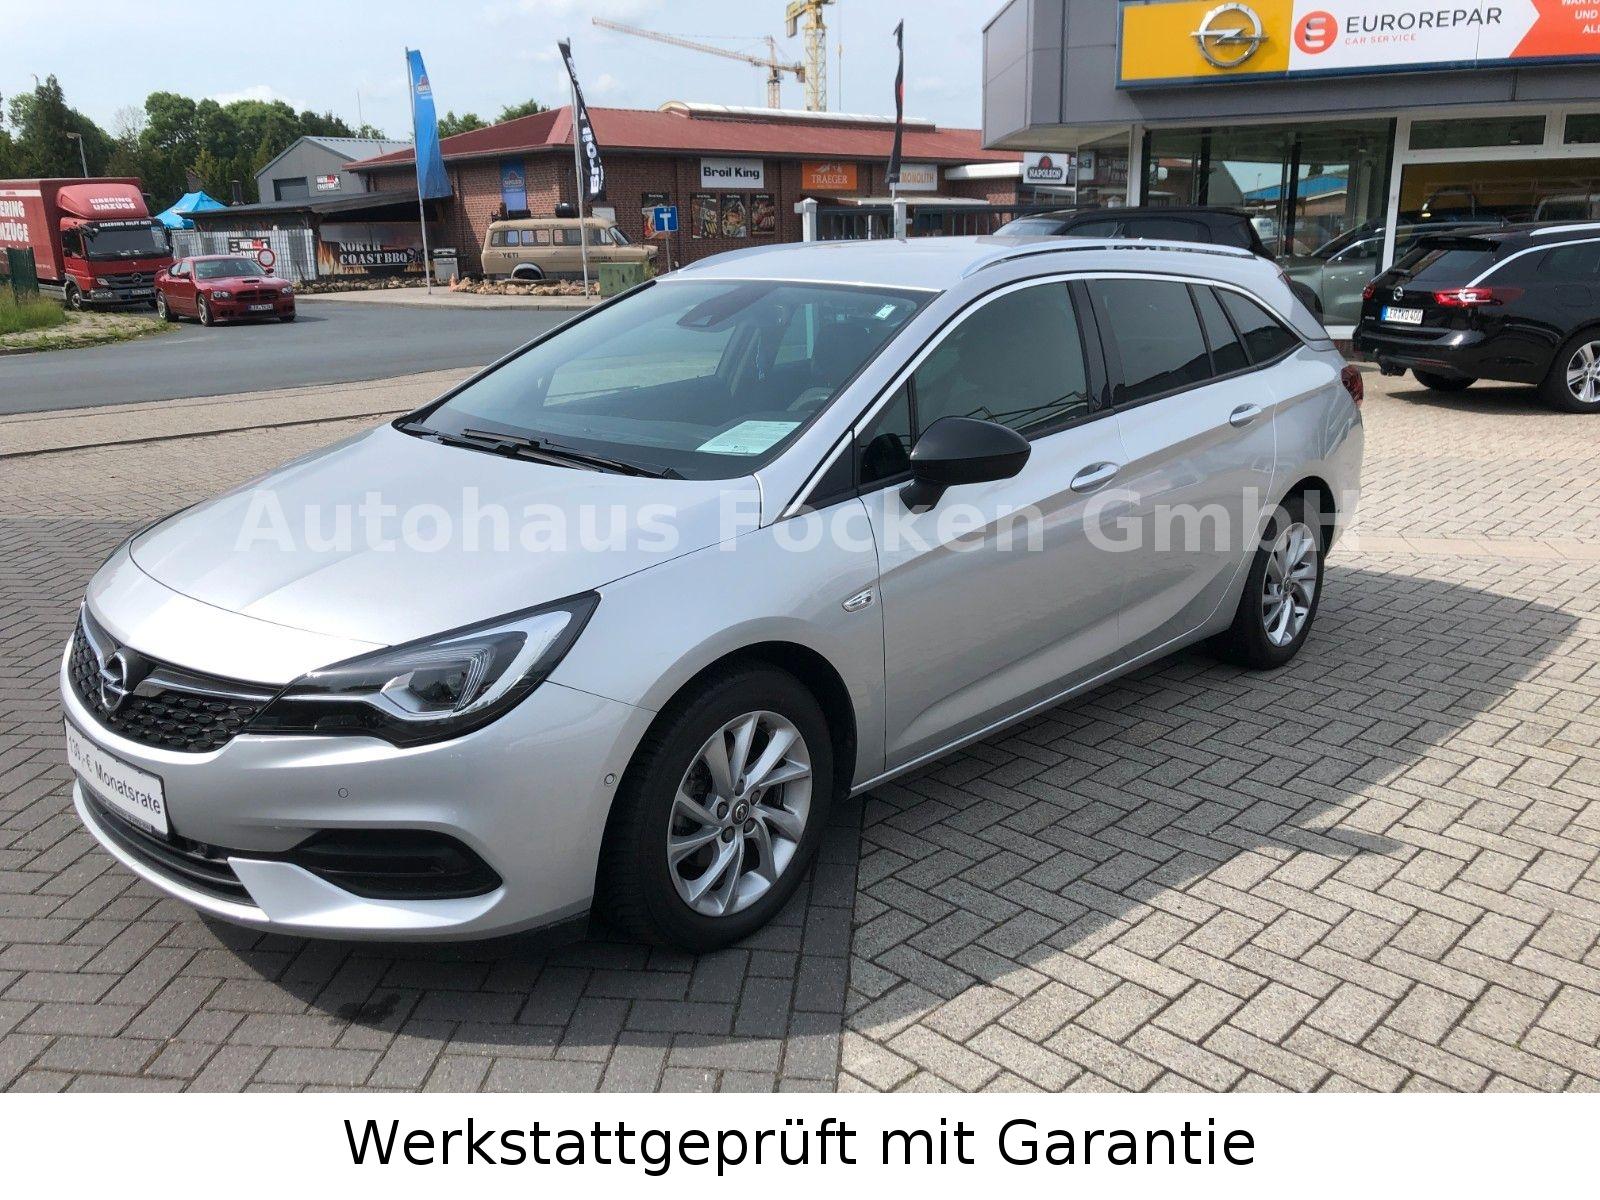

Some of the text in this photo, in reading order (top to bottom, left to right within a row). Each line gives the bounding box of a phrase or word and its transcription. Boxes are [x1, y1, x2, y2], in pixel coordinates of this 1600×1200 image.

[1345, 7, 1502, 34] EUROREPAR
[1575, 10, 1598, 20] UND
[1345, 33, 1417, 45] CAR SERVICE
[703, 166, 760, 179] Broil King
[901, 171, 935, 184] MONOLITH
[1029, 168, 1061, 179] NAPOLEON
[810, 174, 848, 184] TRAEGER
[339, 240, 382, 252] NORTH
[339, 251, 408, 265] COAST BBQ
[502, 251, 519, 259] YETI
[94, 760, 161, 815] Monatsrate
